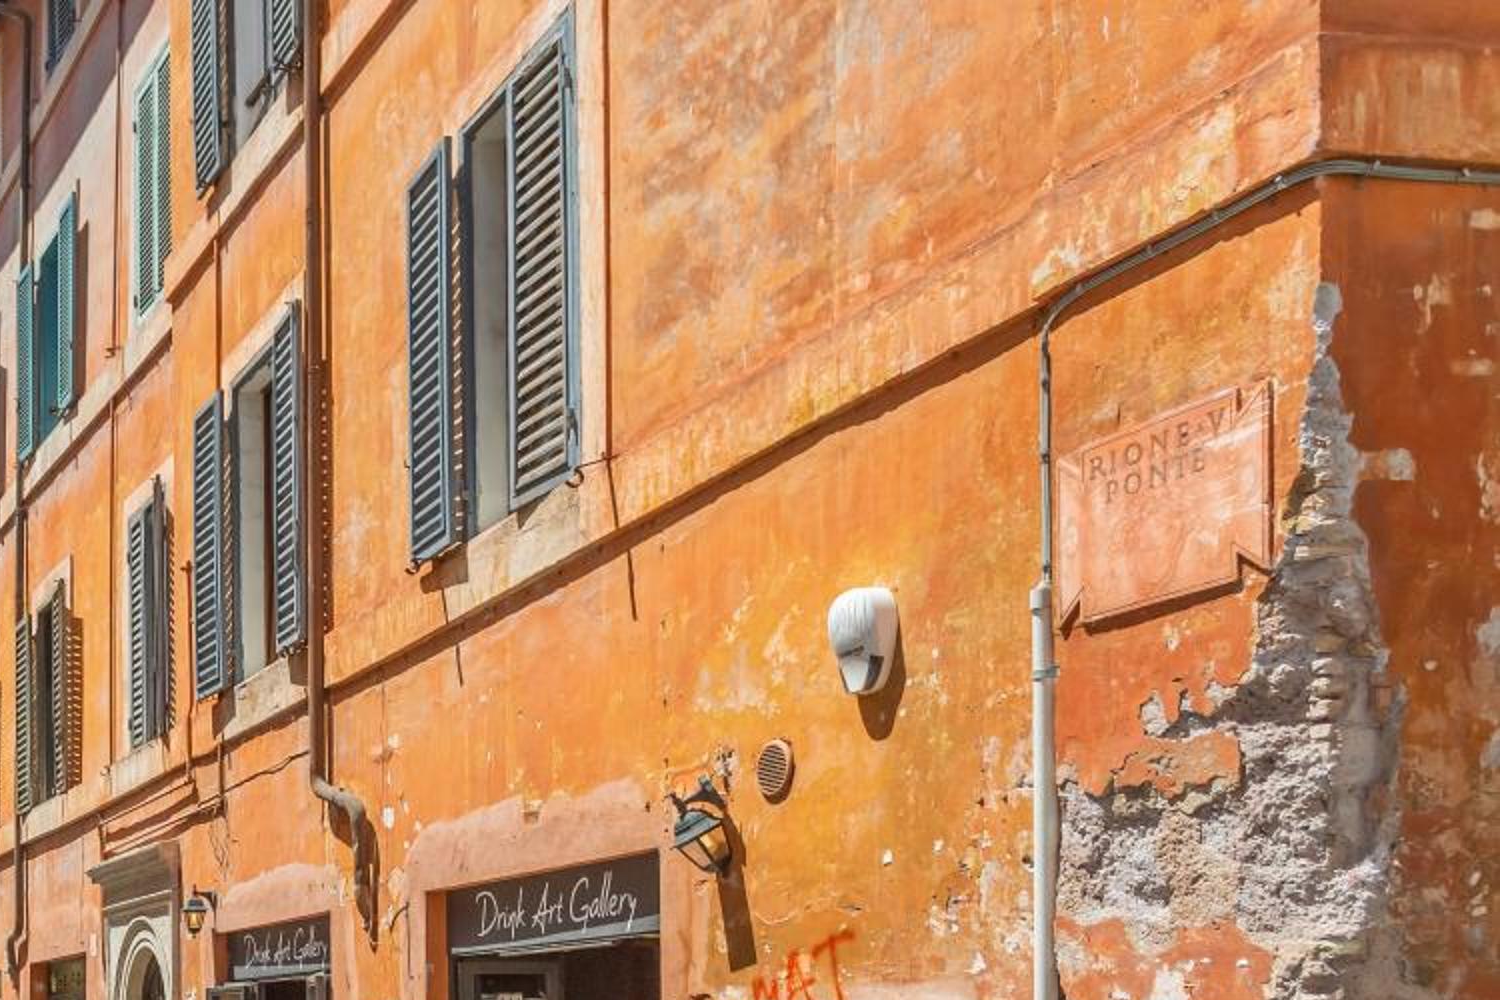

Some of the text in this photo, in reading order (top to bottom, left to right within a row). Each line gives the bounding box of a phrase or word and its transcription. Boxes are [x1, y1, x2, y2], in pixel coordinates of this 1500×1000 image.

[1089, 421, 1190, 482] RIONE
[1106, 447, 1206, 503] PONTE
[475, 869, 638, 941] Drink Art Gallery
